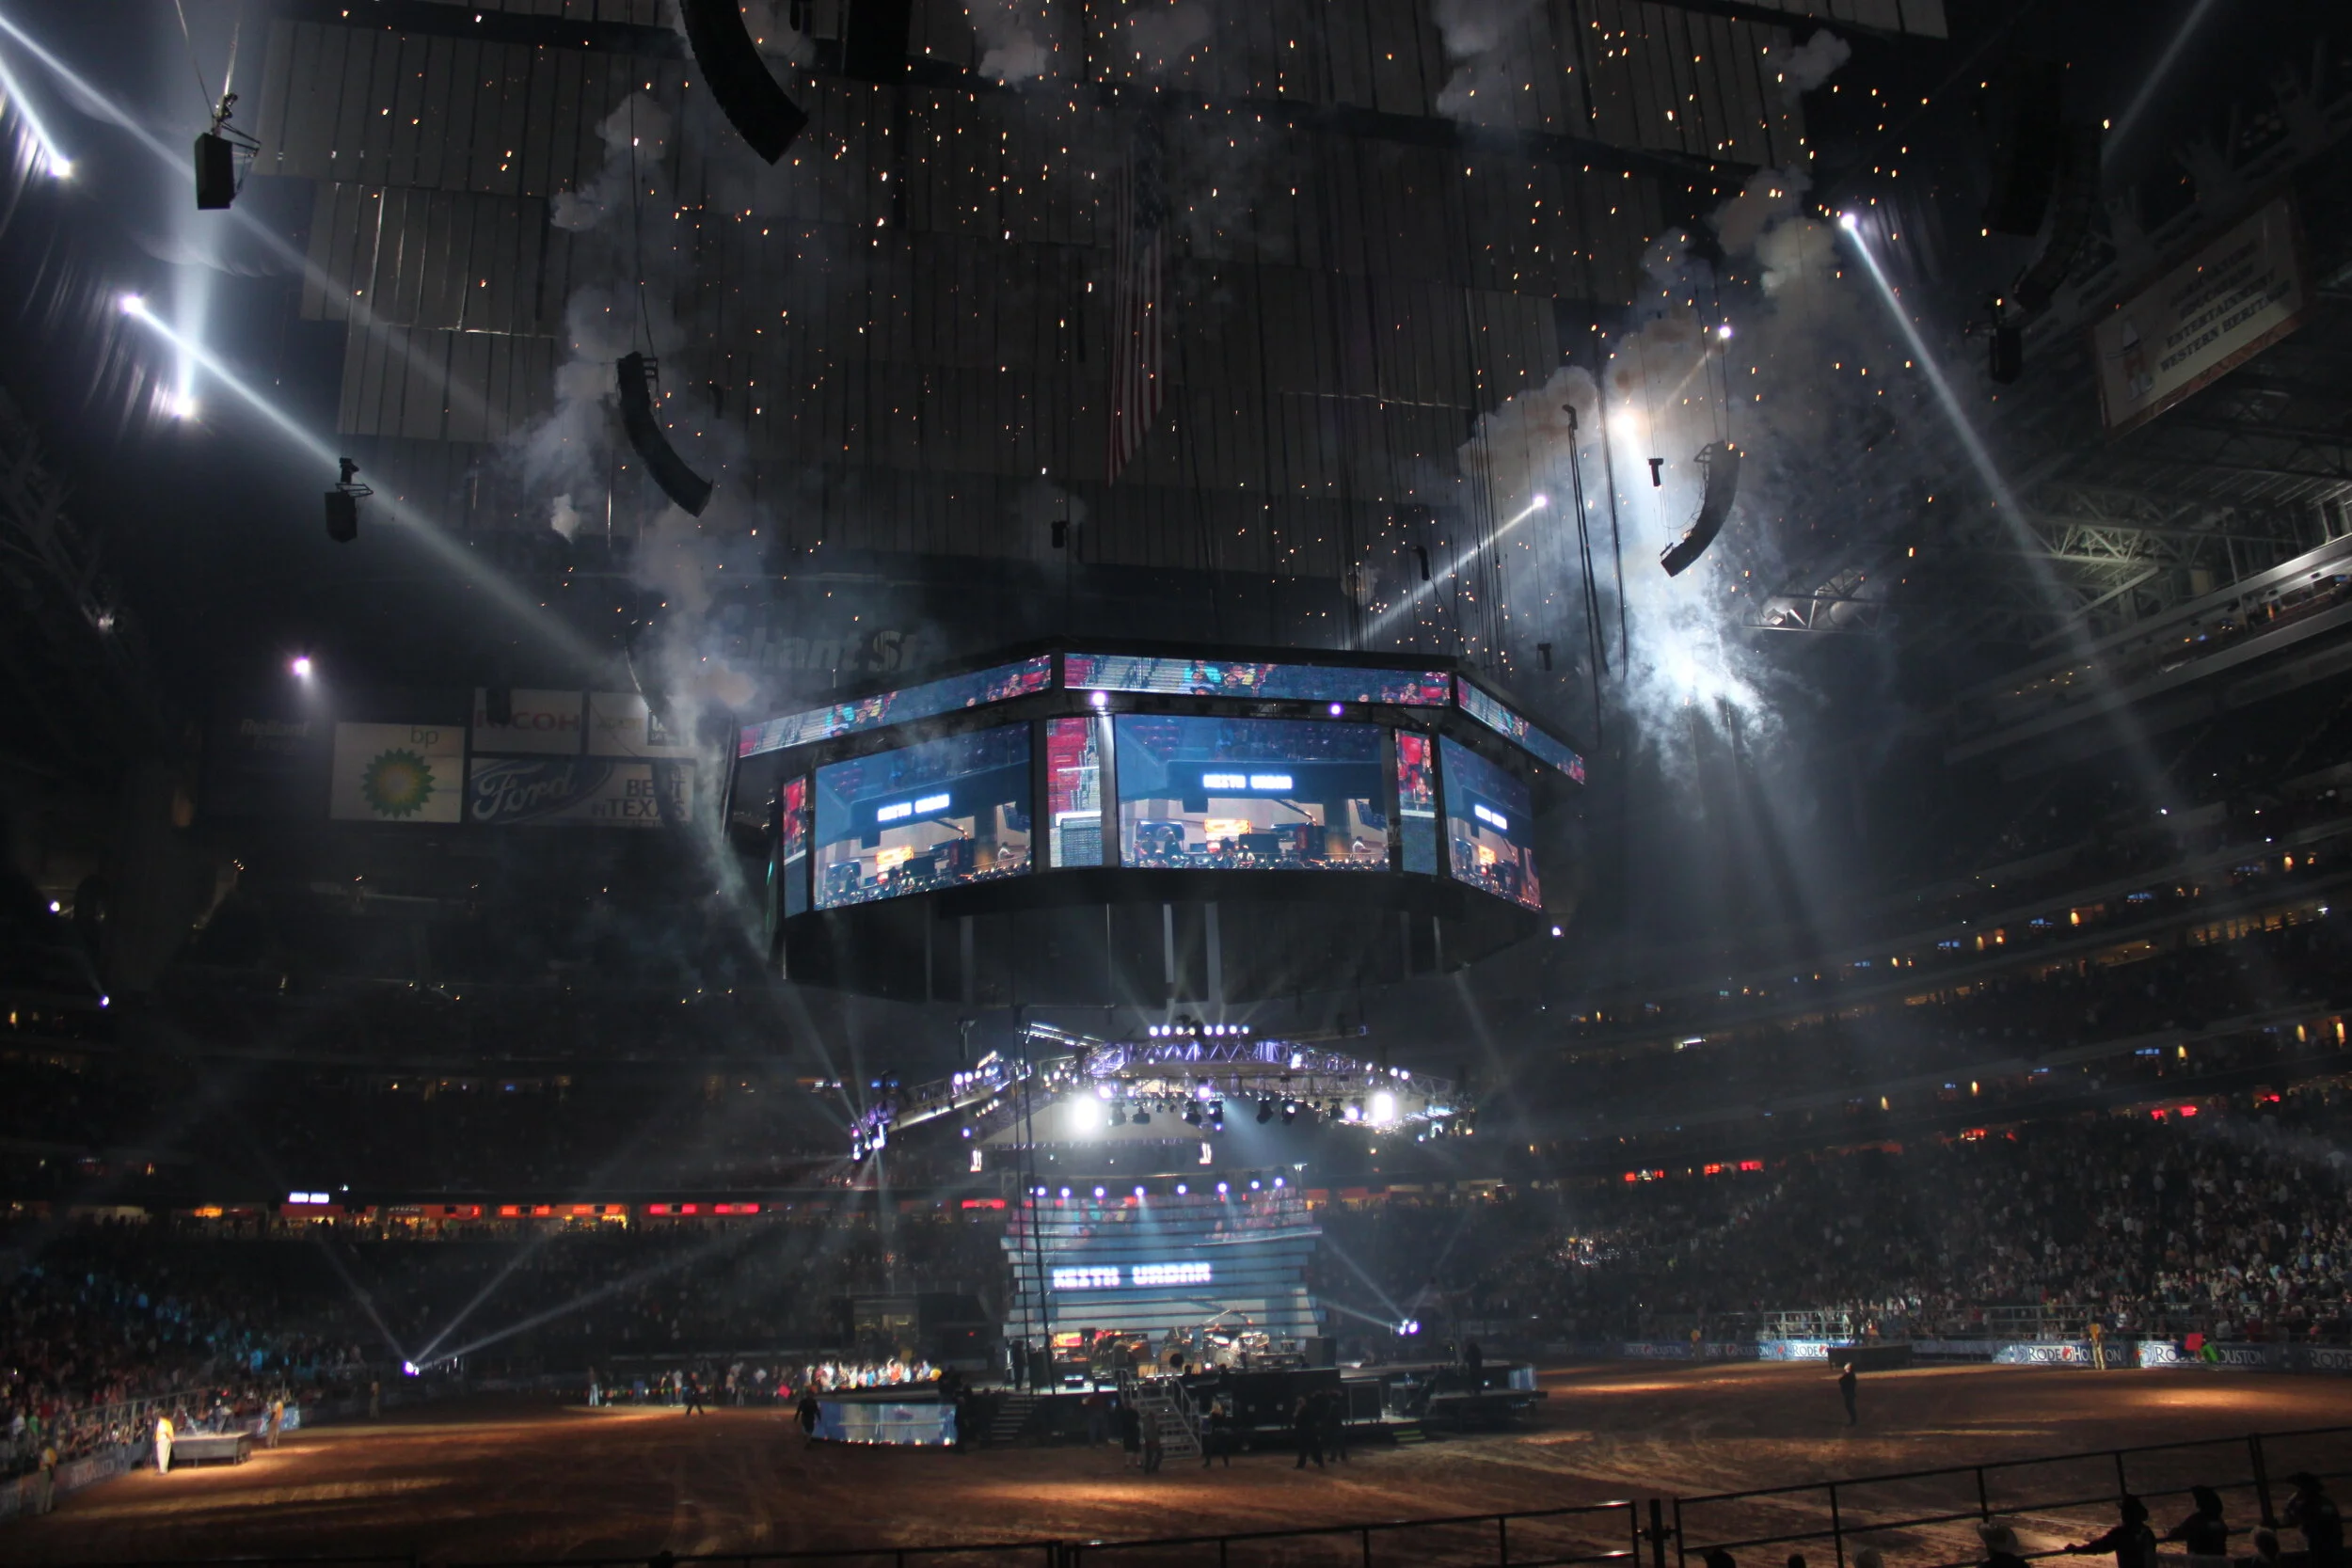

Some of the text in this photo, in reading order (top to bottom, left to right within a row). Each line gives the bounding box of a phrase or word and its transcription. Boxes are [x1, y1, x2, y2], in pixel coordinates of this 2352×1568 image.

[2160, 325, 2218, 372] WESTERN
[410, 725, 439, 749] bp
[472, 760, 577, 822] Ford
[627, 778, 686, 798] BET
[607, 798, 686, 817] TEXS
